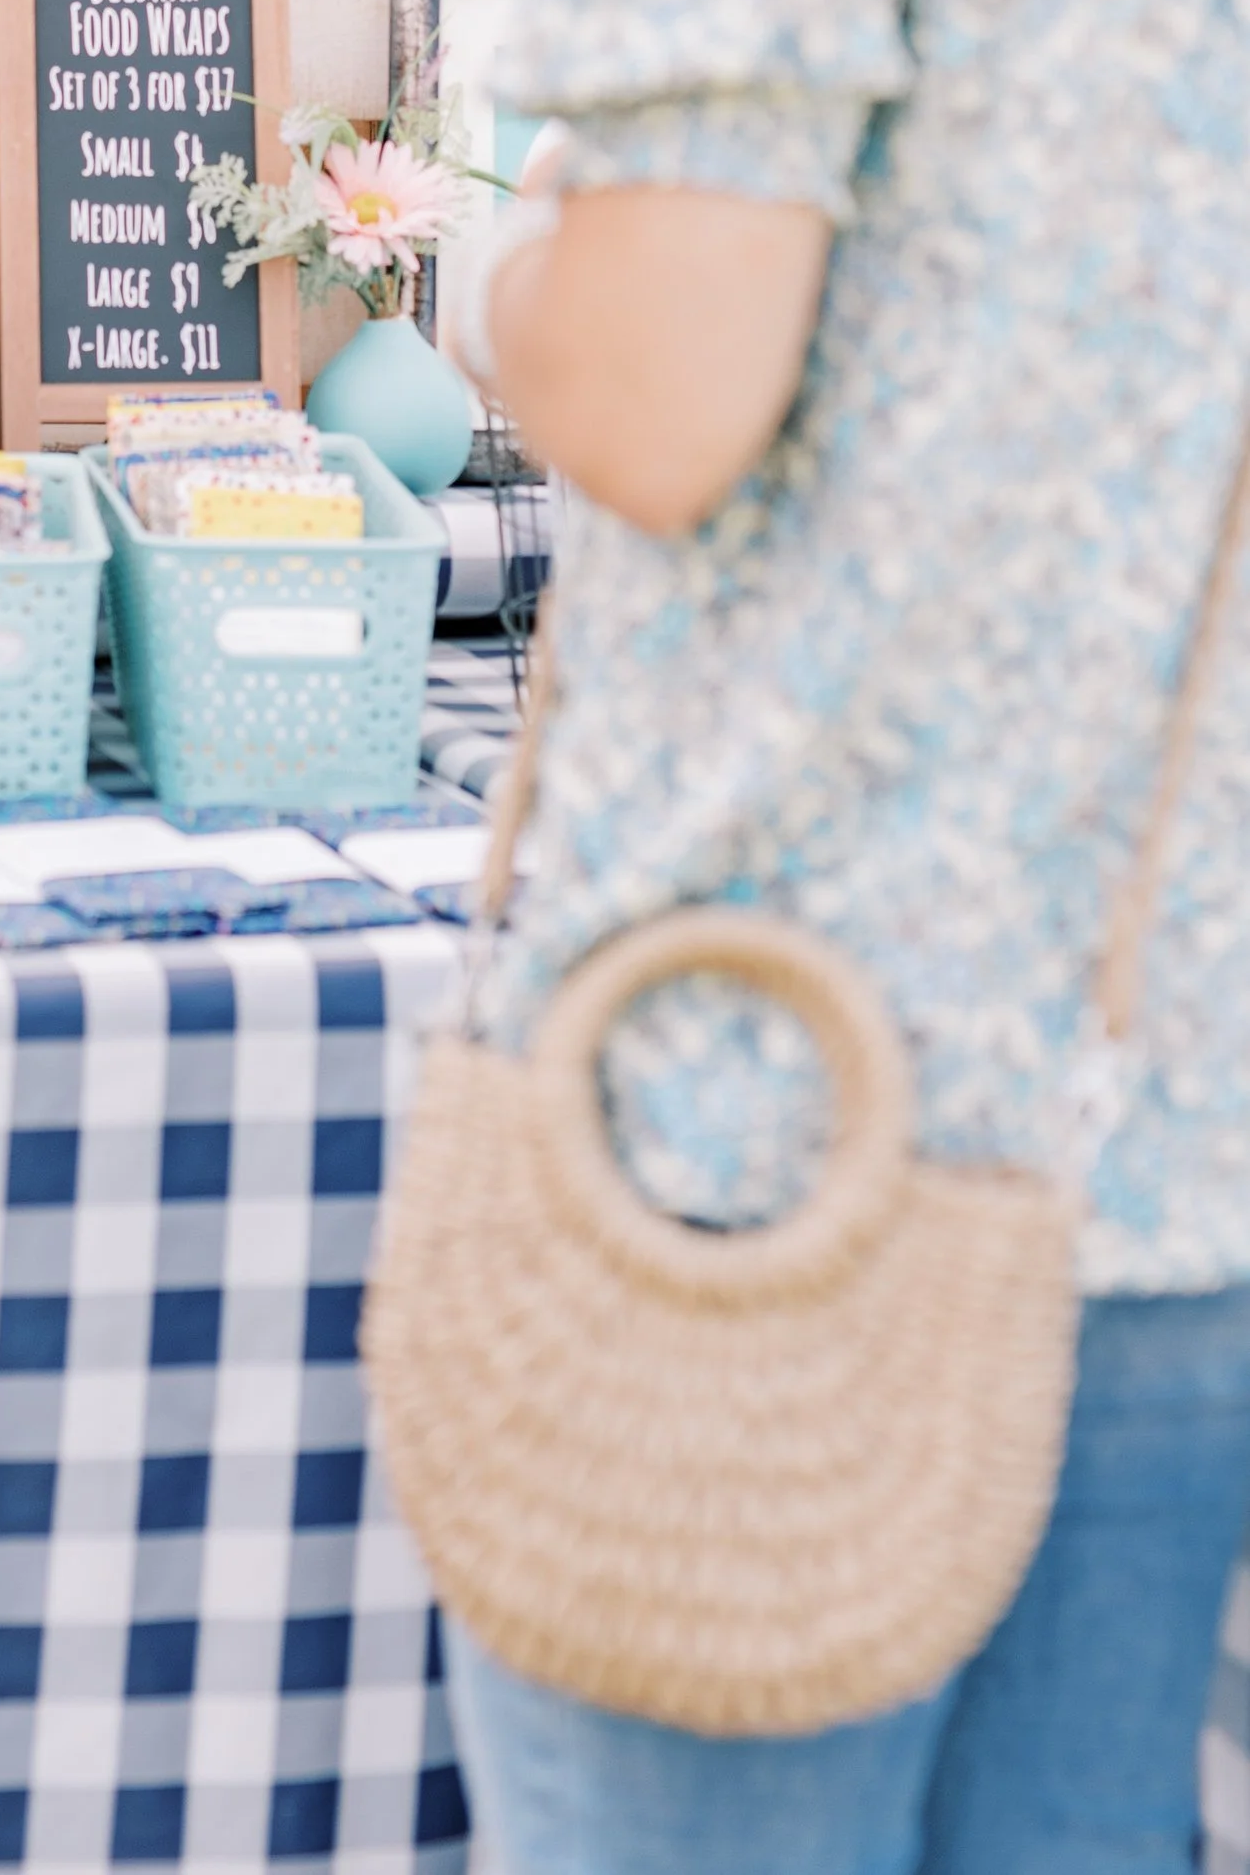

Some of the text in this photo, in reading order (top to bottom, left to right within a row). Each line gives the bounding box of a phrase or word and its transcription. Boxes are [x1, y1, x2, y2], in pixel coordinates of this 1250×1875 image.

[69, 1, 230, 57] FOOD WRAPS
[48, 65, 236, 118] SET OF 3 FOR $17
[80, 130, 205, 182] SMALL $4
[70, 198, 166, 246] MEDIUM
[86, 261, 199, 314] LARGE $9
[180, 322, 221, 375] $11
